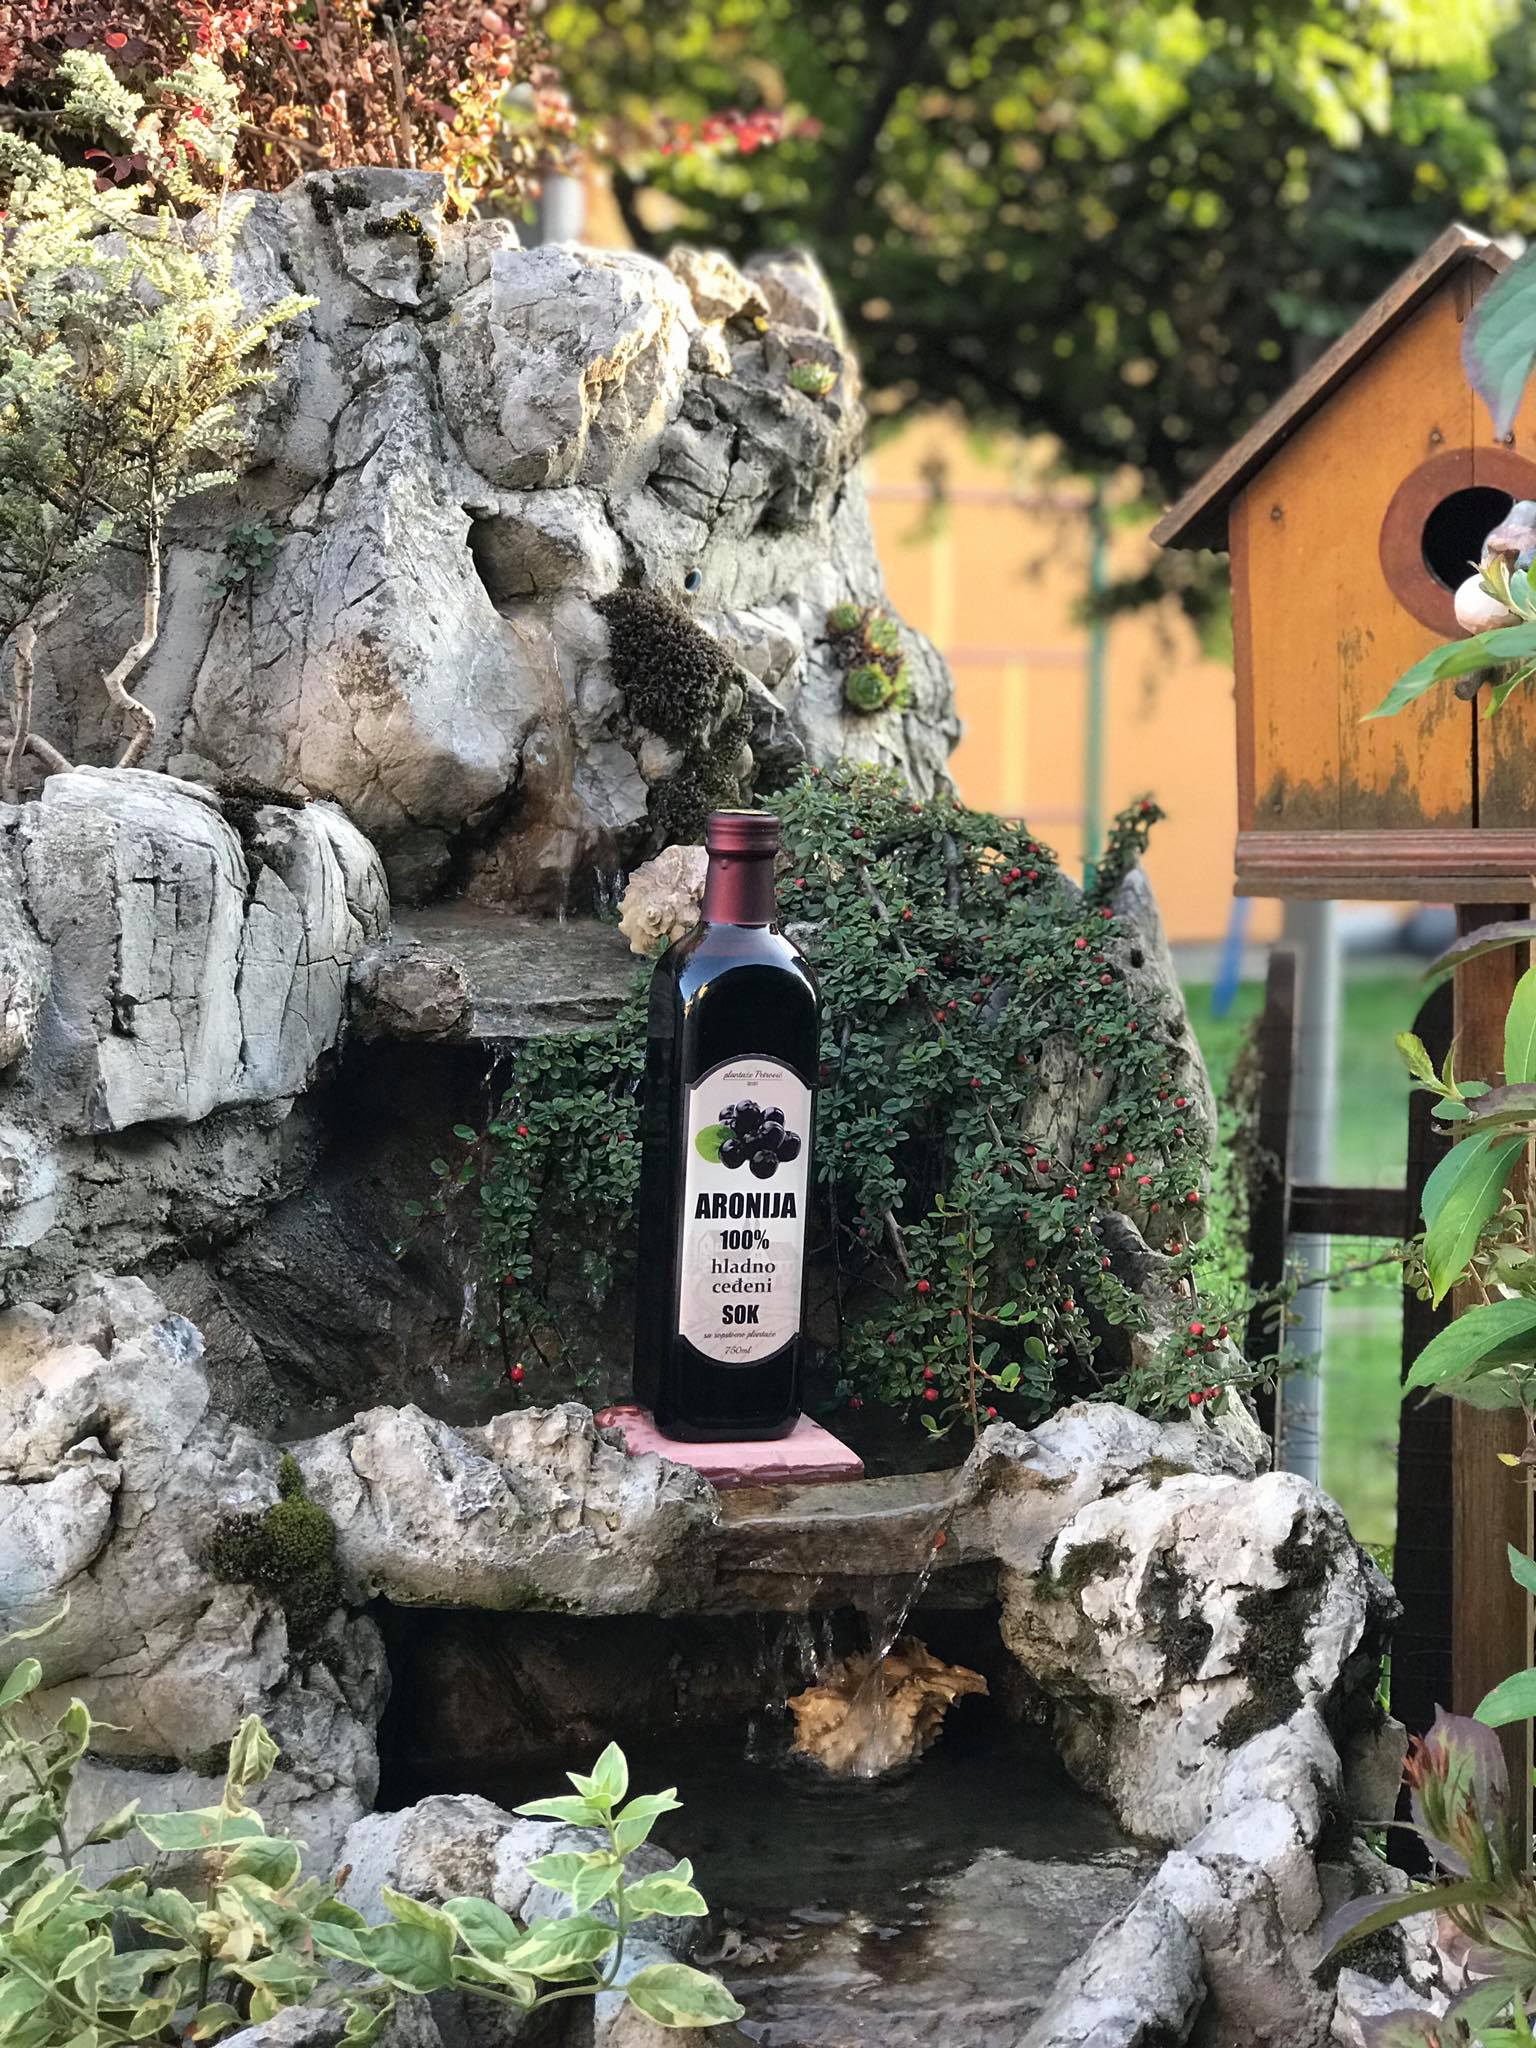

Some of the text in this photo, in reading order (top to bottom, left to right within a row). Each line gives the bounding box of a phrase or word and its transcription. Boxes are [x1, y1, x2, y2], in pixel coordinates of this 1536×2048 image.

[694, 1192, 797, 1219] ARONIJA
[719, 1229, 770, 1250] 100%
[711, 1258, 776, 1274] hladno
[712, 1277, 772, 1294] ceđeni
[722, 1304, 760, 1325] SOK
